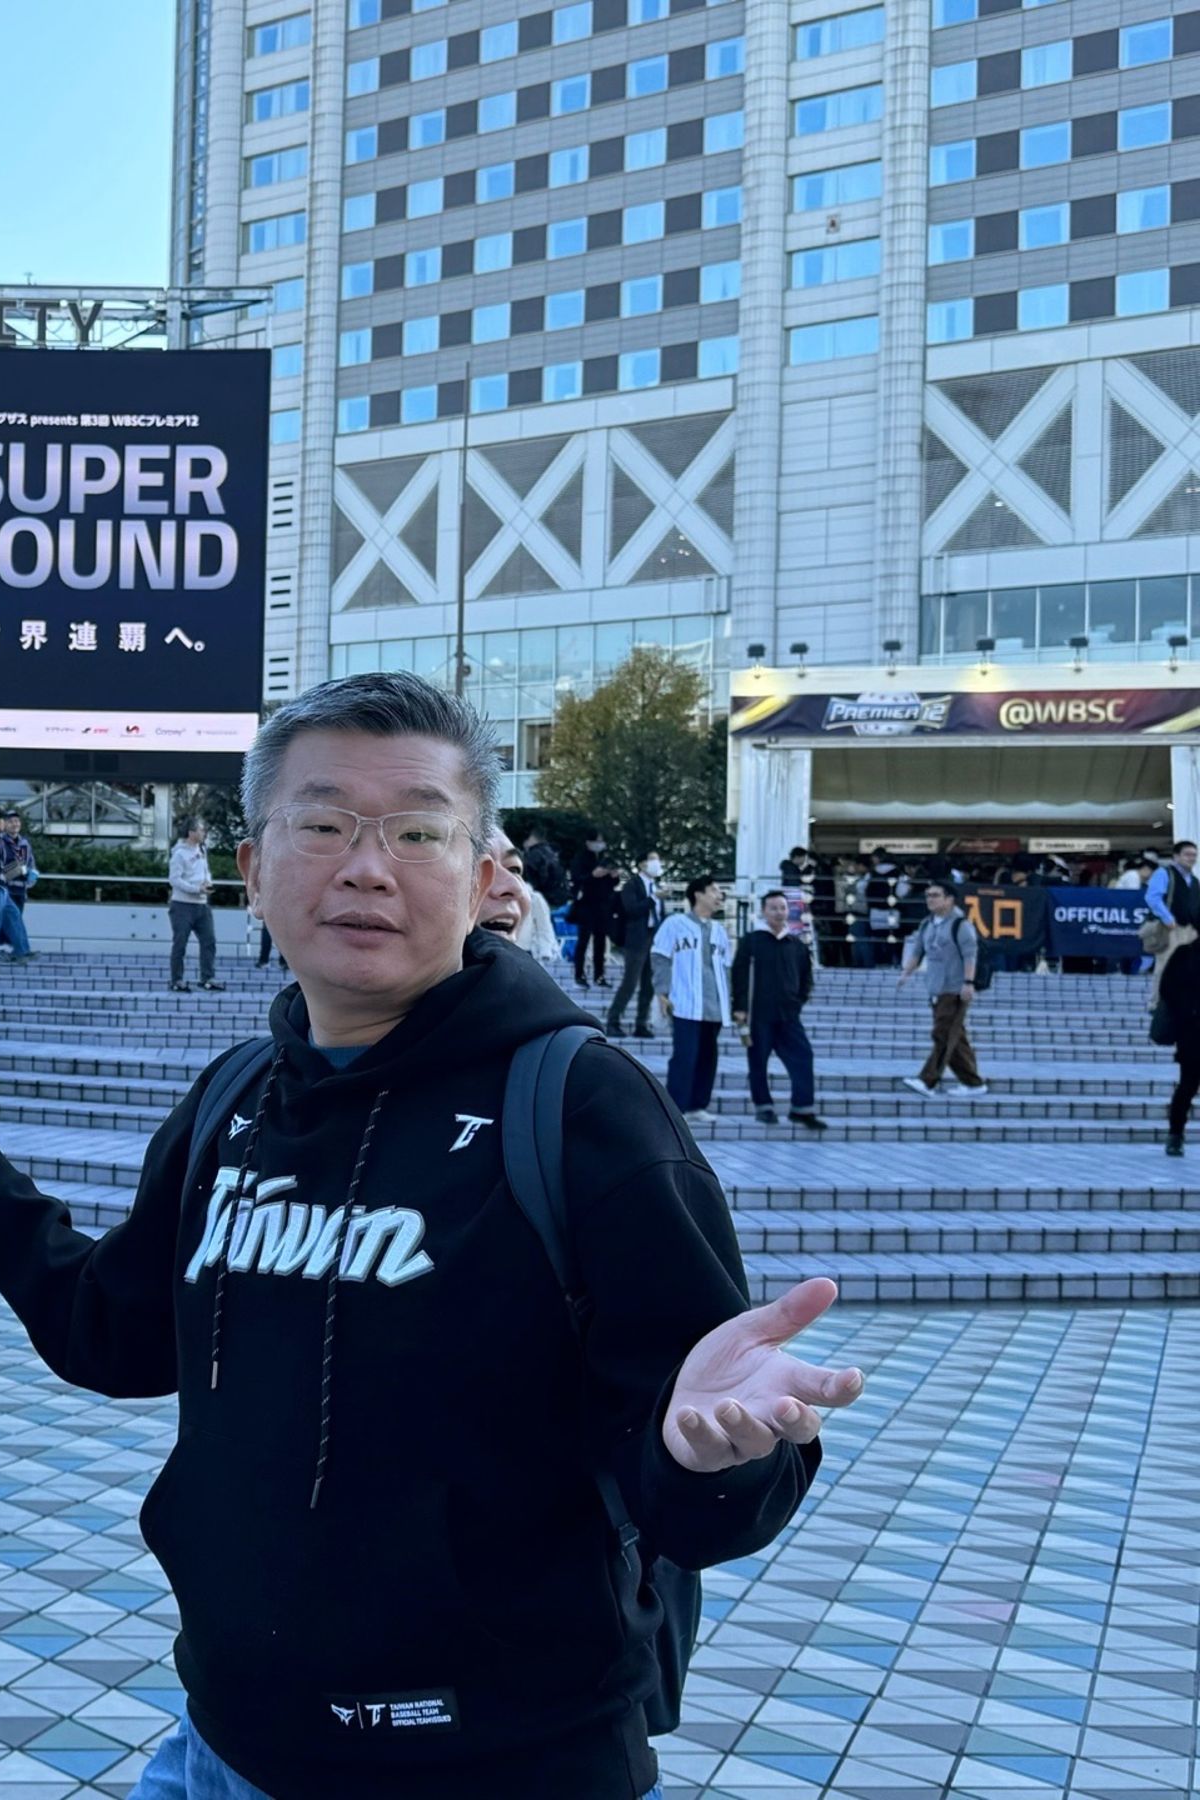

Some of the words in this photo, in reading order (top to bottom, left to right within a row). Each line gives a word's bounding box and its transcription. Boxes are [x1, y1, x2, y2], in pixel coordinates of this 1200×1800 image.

[30, 415, 78, 427] presents
[830, 703, 918, 721] PREMIER
[922, 703, 947, 721] 12
[1000, 698, 1125, 730] @WBSC
[964, 896, 1023, 940] 入口
[1054, 907, 1131, 924] OFFICIAL
